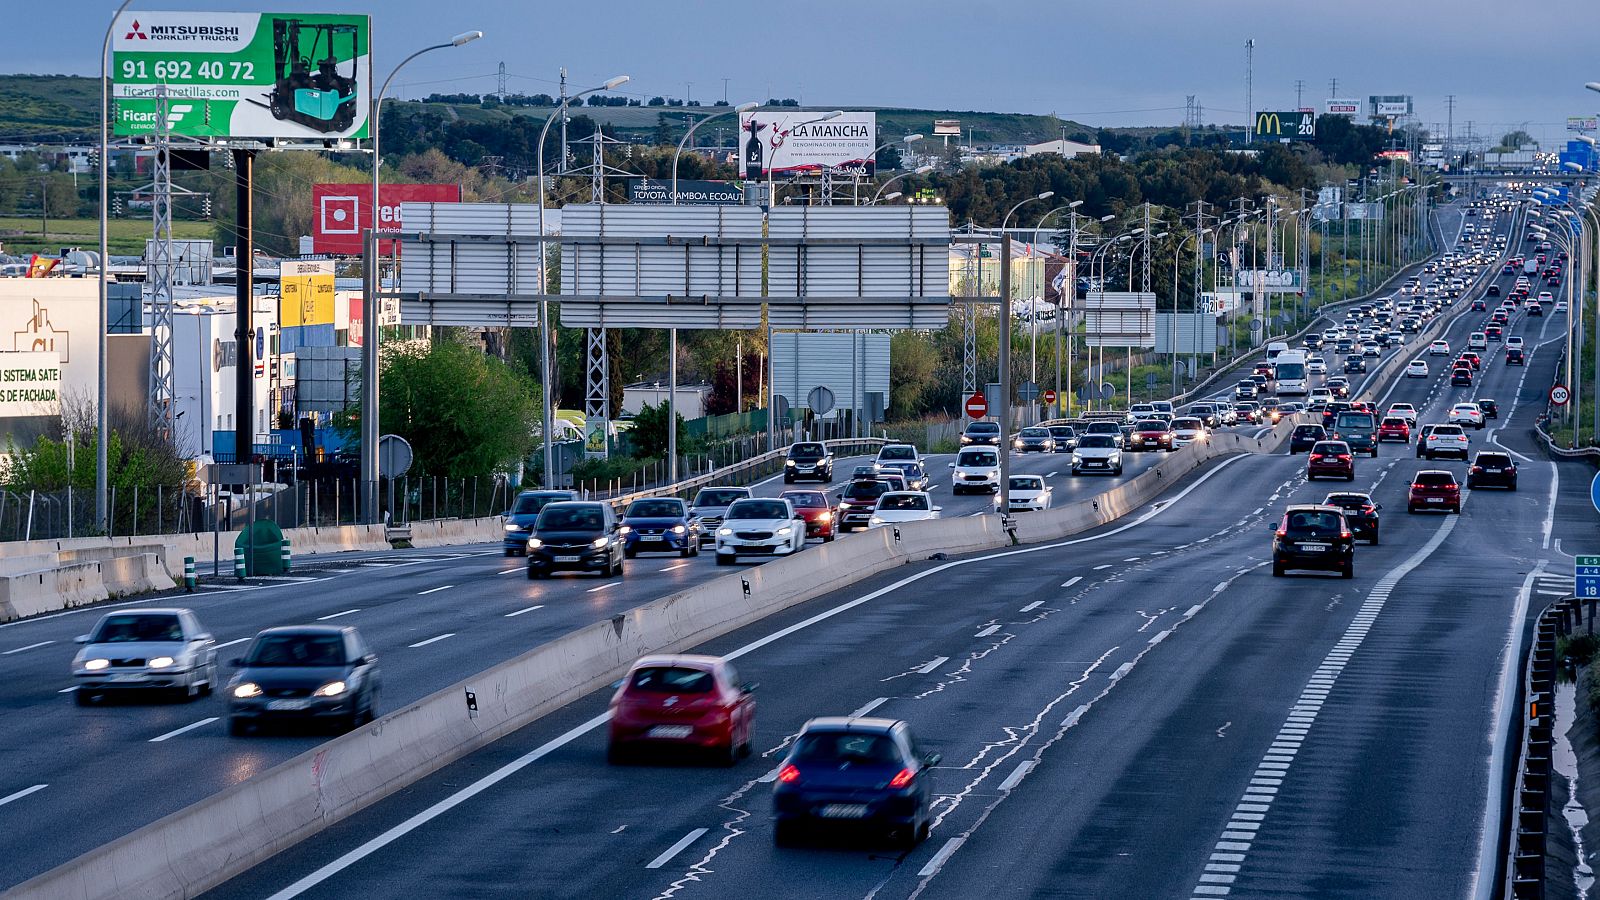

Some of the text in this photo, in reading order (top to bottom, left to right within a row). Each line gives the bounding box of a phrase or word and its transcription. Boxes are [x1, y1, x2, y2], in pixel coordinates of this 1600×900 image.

[151, 26, 239, 35] MITSUBISHI
[122, 60, 255, 80] 91 692 40 72
[792, 125, 869, 137] LA MANCHA
[1298, 124, 1313, 135] 20
[634, 191, 667, 199] TOYOTA
[3, 369, 37, 382] SISTEMA
[38, 368, 58, 381] SATE
[7, 389, 18, 402] DE
[19, 388, 57, 402] FACHADA
[1552, 391, 1567, 399] 100
[1583, 557, 1598, 565] E-5
[1584, 586, 1597, 596] 18
